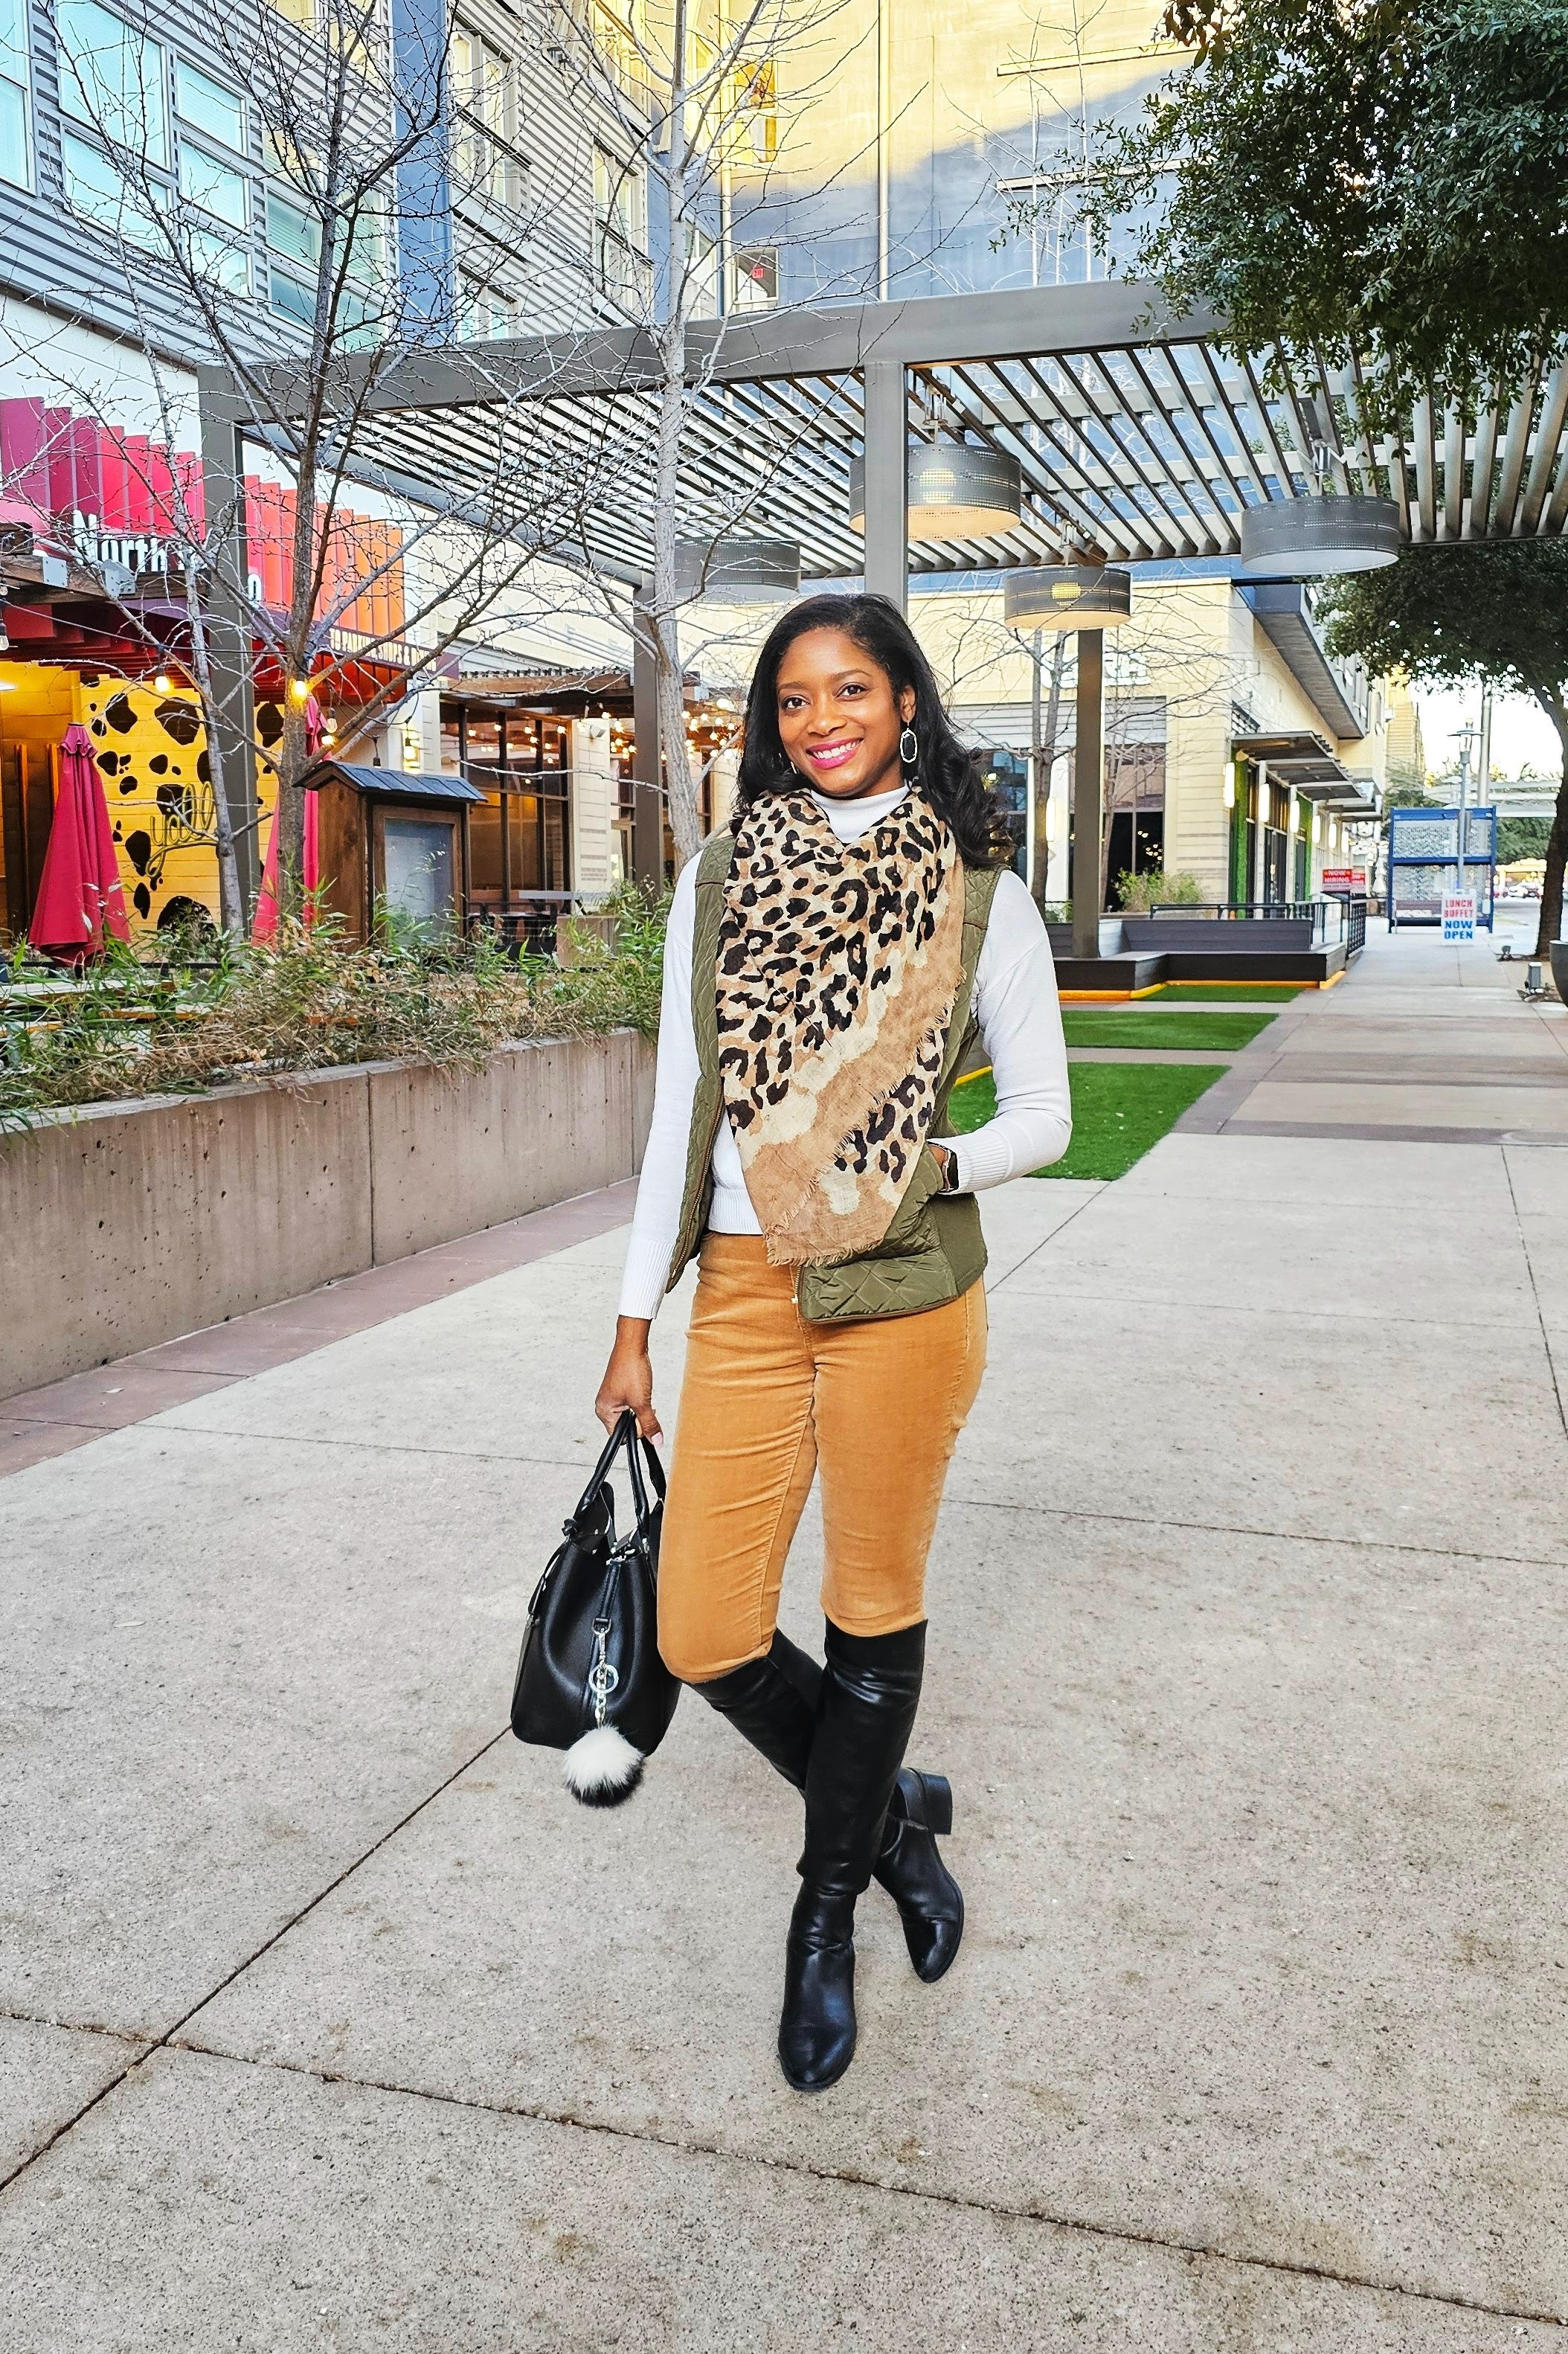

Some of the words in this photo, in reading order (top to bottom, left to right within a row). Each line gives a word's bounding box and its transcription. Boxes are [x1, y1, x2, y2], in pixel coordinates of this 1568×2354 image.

[377, 641, 402, 664] SHOPS
[403, 645, 411, 666] &
[1445, 899, 1473, 908] LUNCH
[1444, 909, 1474, 918] BUFFET
[1445, 920, 1473, 929] NOW
[1444, 930, 1473, 940] OPEN
